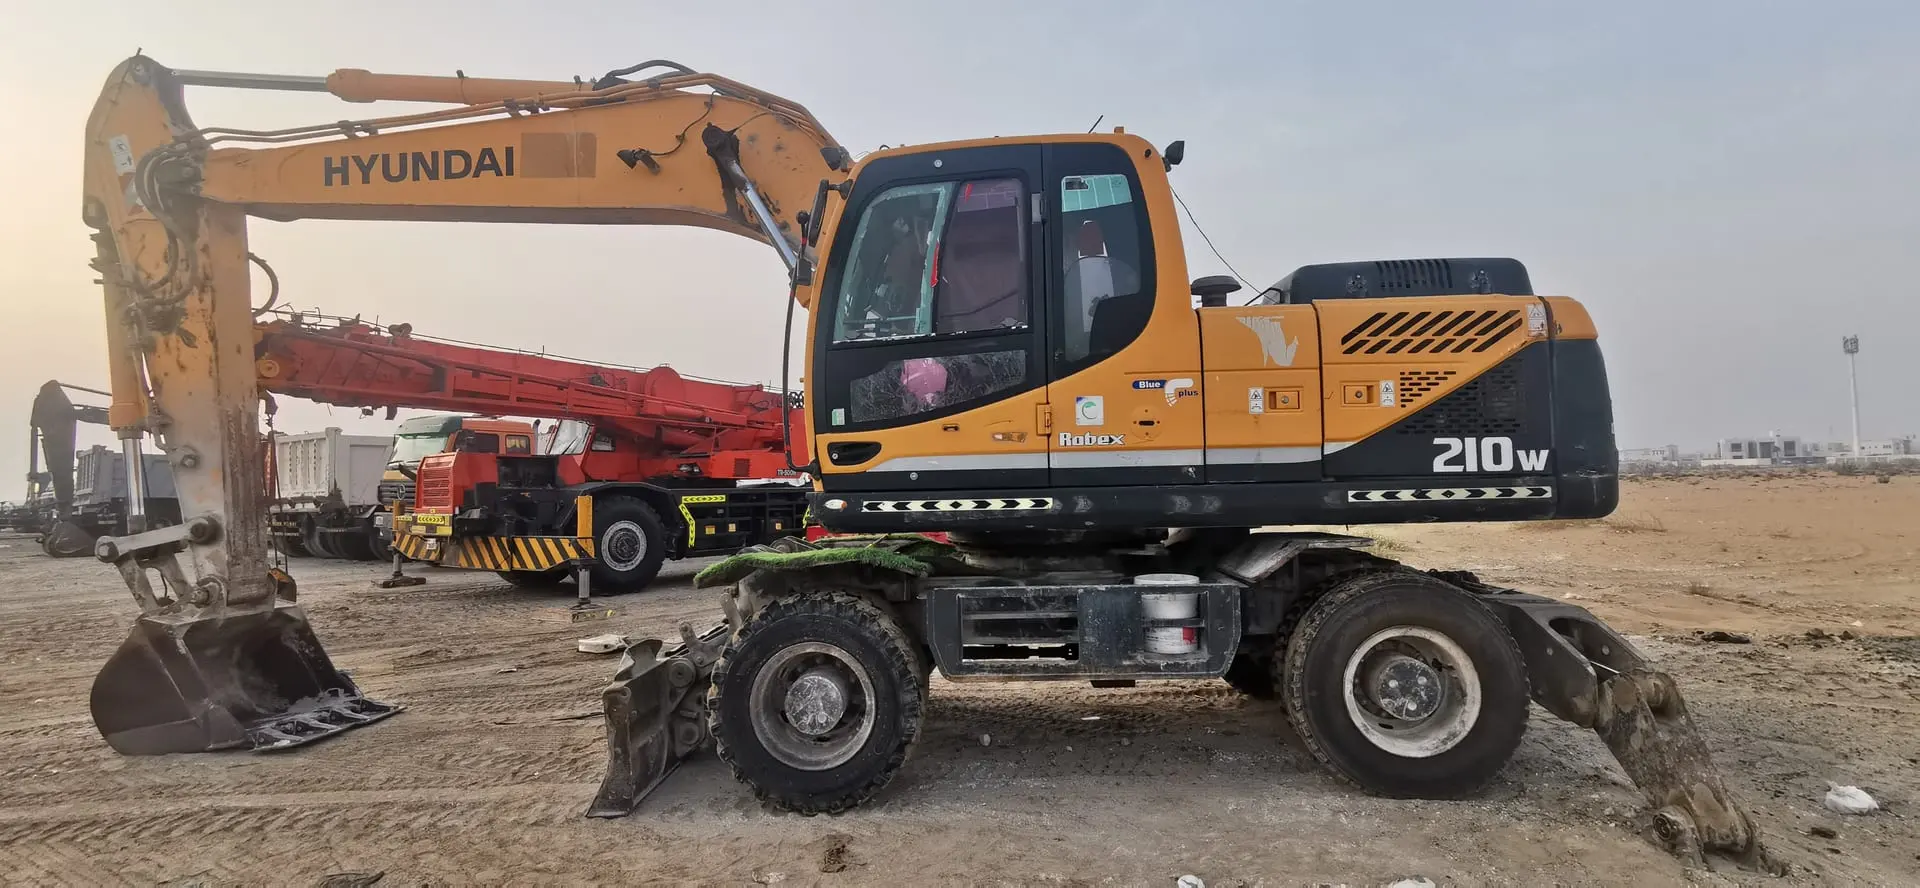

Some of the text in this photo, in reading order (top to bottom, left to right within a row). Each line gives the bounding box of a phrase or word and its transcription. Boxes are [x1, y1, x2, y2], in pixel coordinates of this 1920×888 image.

[324, 146, 514, 186] HYUNDAI
[1138, 380, 1199, 398] Blue plus
[1059, 431, 1126, 446] Robex
